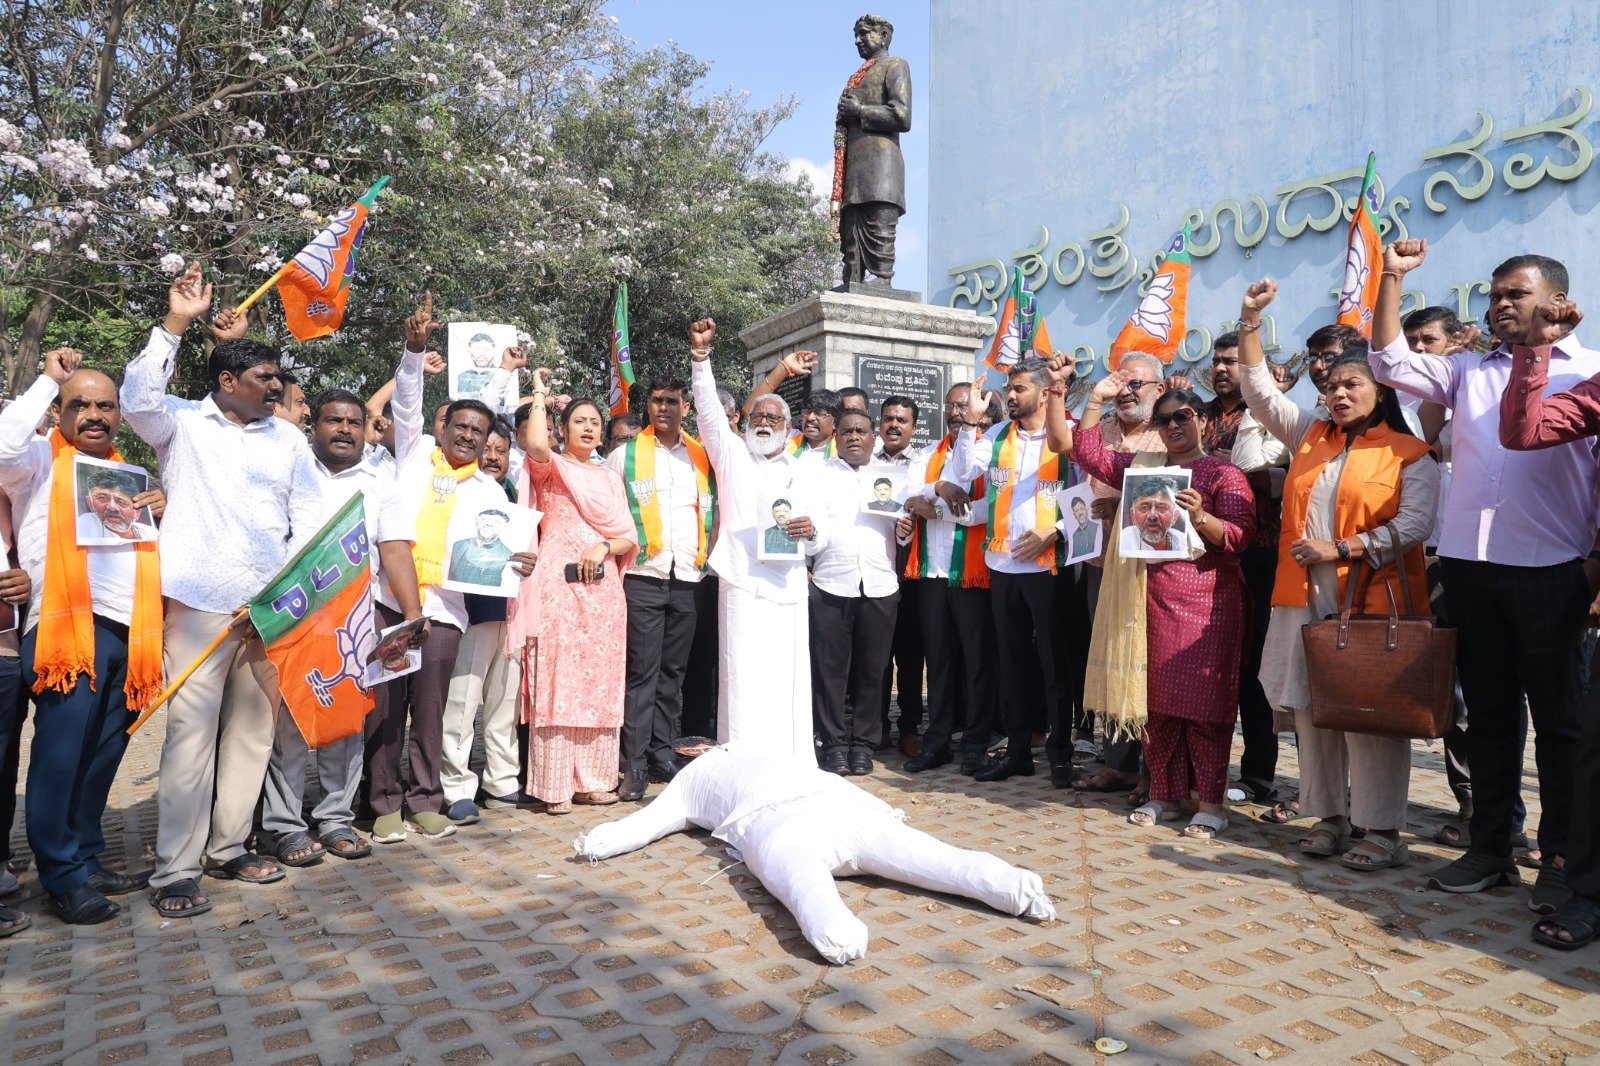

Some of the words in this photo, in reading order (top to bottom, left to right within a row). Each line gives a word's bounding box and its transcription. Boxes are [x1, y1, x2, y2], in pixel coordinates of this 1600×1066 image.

[875, 372, 904, 385] ಕುವೆಂಪು
[905, 374, 930, 387] ಪ್ರತಿಮೆ
[271, 519, 369, 620] BJP
